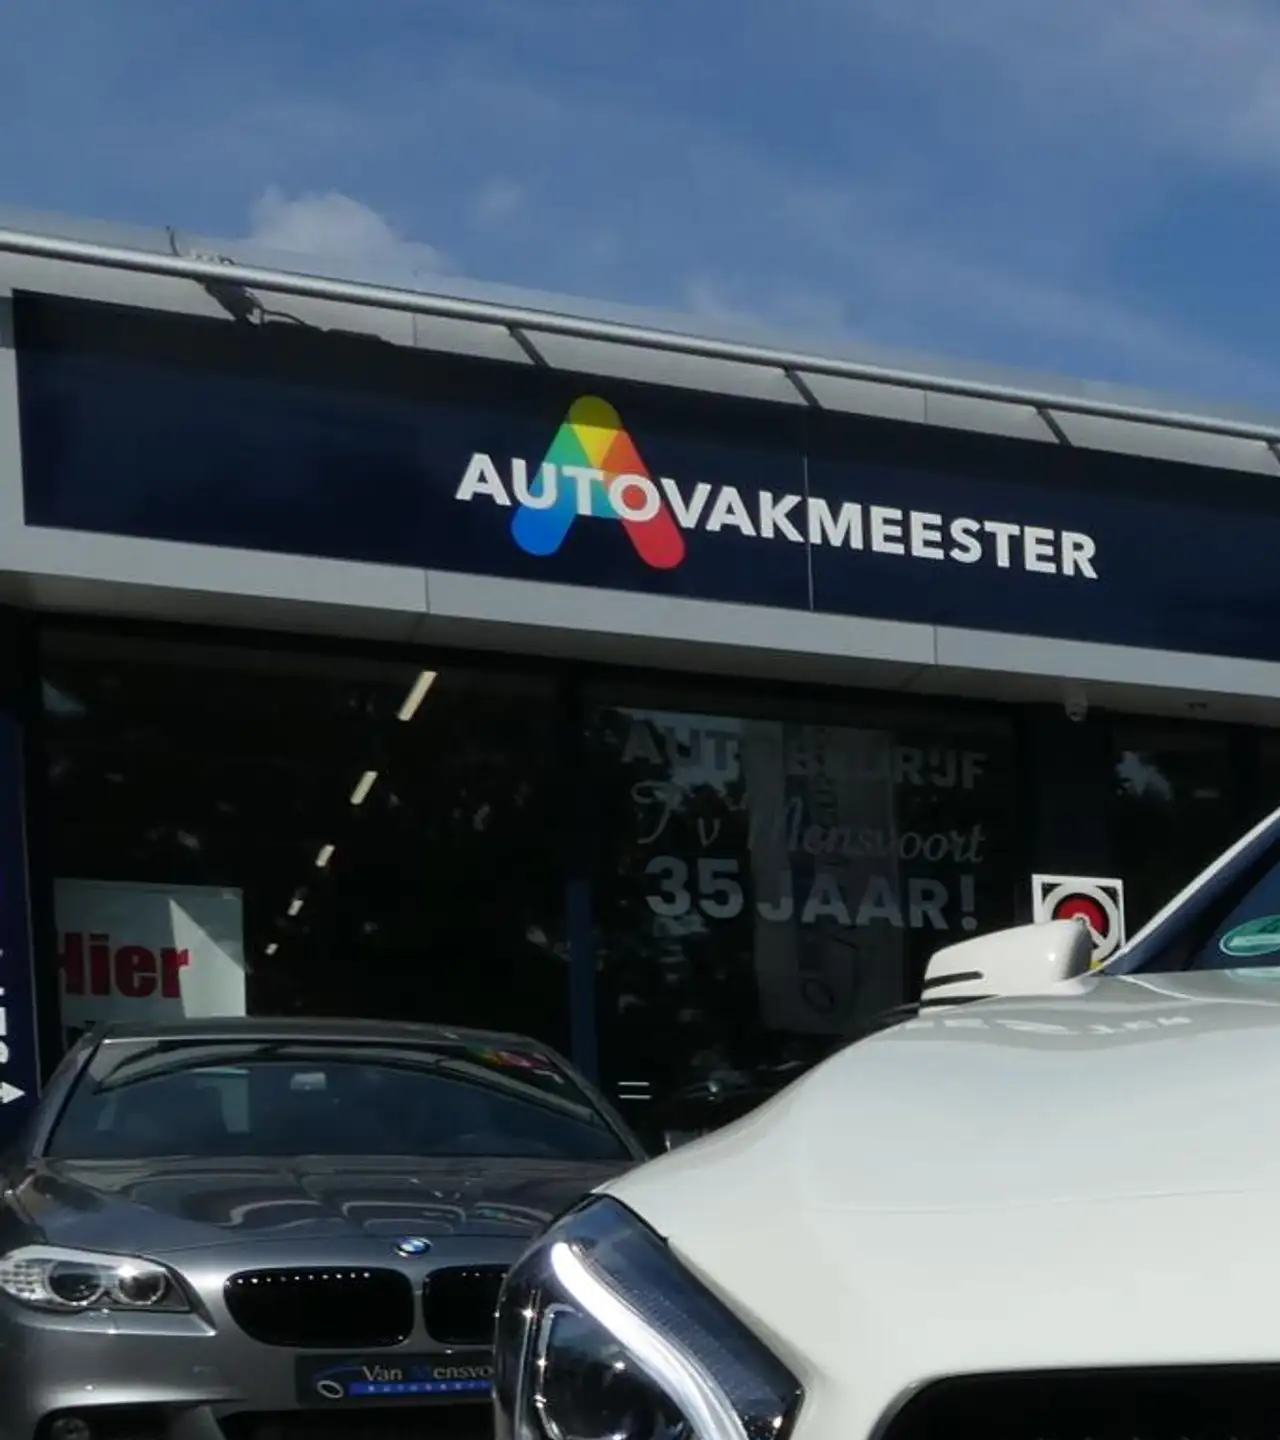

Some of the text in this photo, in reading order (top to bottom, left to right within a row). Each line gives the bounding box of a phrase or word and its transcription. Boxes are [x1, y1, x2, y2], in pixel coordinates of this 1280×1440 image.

[455, 451, 1099, 580] AUTOVAKMEESTER
[620, 720, 988, 790] AUTBDRIJF
[643, 855, 980, 931] 35 JAAR!
[362, 1364, 403, 1381] Van
